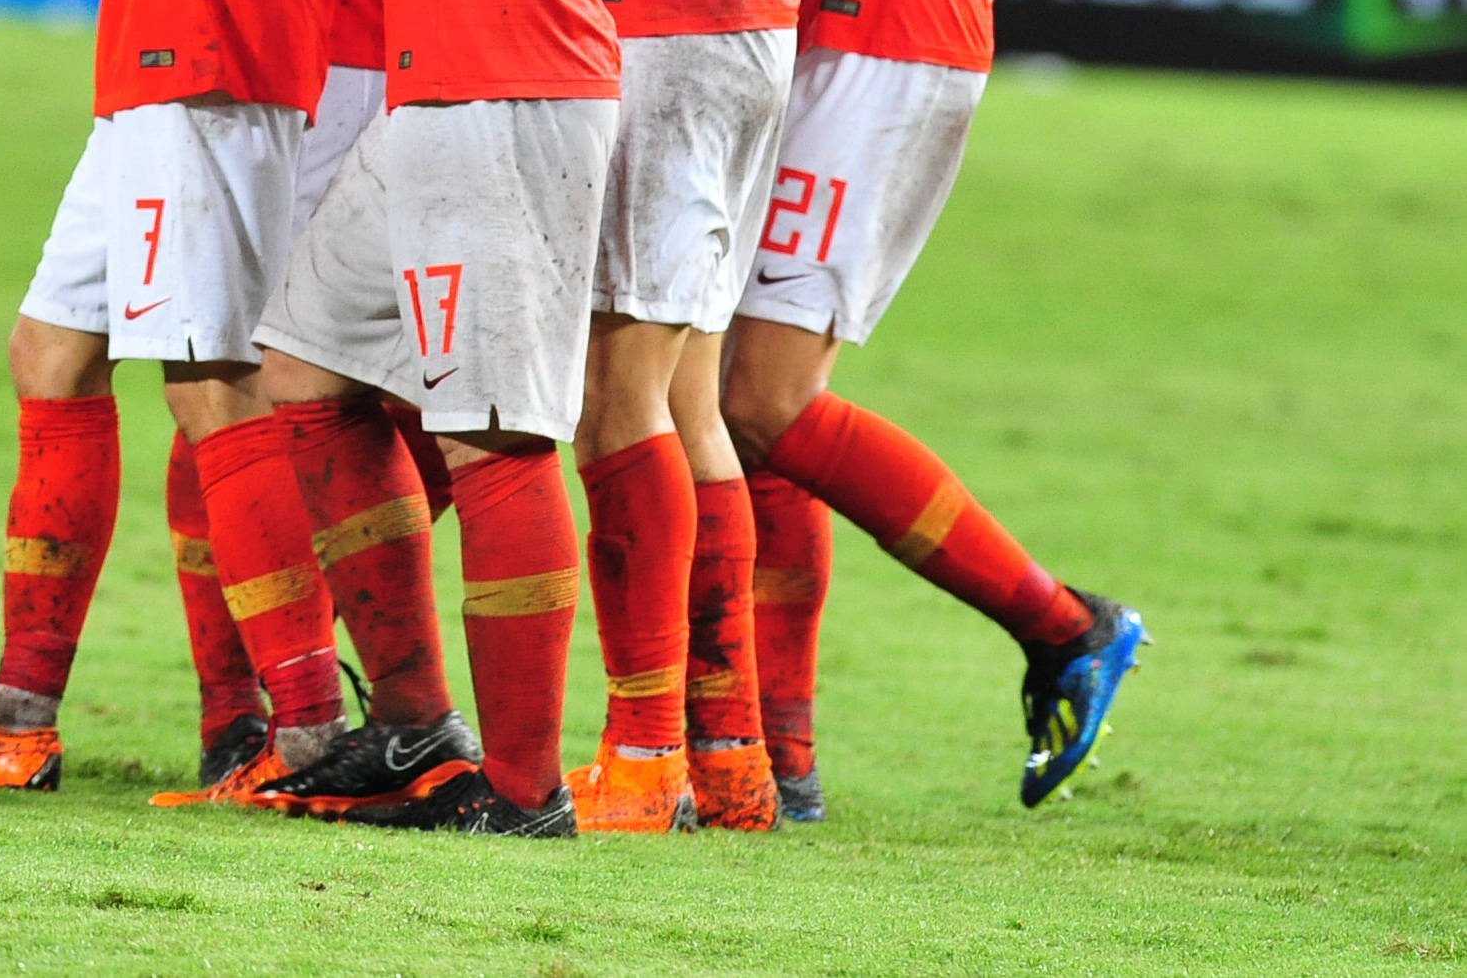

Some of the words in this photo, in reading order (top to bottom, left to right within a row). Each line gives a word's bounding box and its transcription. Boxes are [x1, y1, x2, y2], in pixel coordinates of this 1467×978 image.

[135, 198, 165, 286] 7
[759, 167, 848, 263] 21
[403, 264, 463, 357] 17
